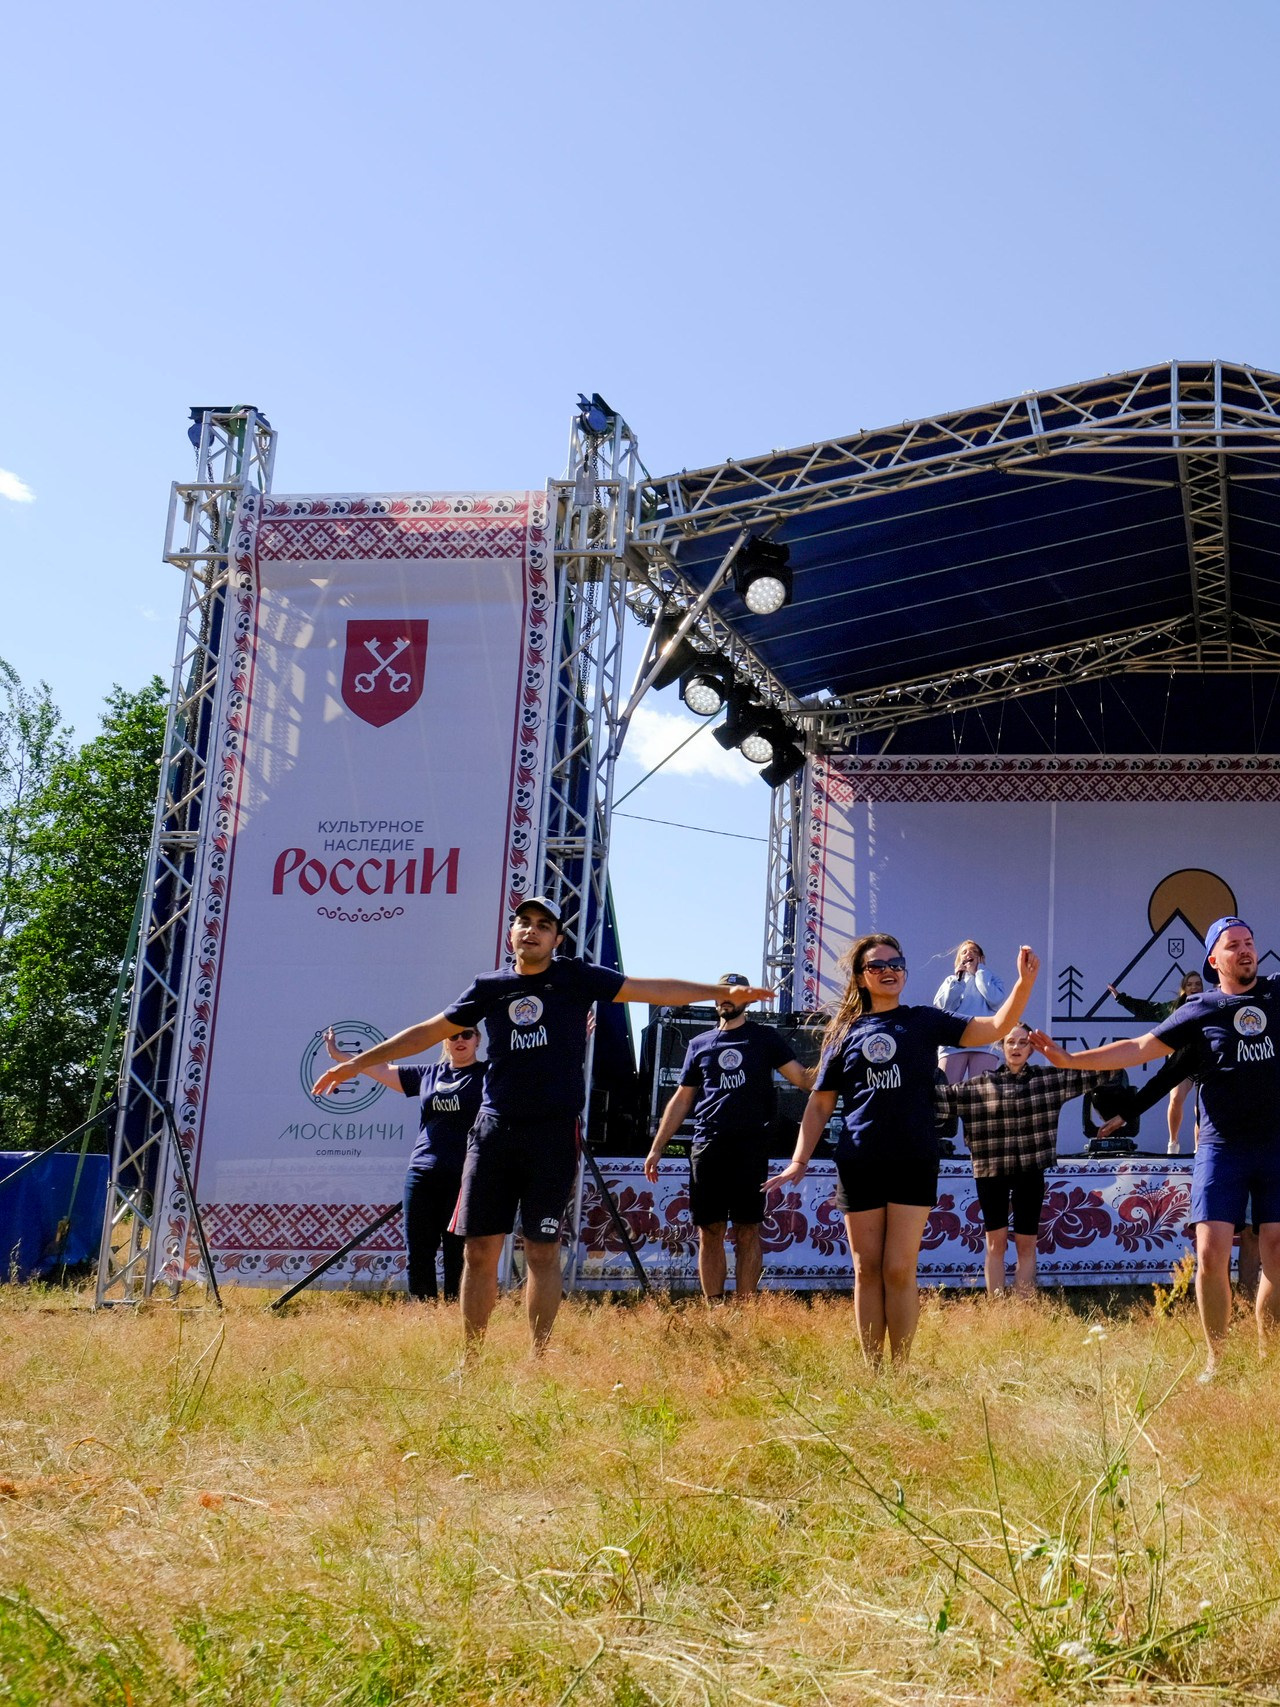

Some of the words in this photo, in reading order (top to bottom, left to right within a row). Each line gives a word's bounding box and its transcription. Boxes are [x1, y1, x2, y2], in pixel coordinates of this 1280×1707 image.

[318, 820, 424, 833] КУЛЬТУРНОЕ
[324, 839, 415, 853] НАСЛЕДИЕ
[278, 1123, 404, 1140] МОСКВИЧИ
[316, 1148, 362, 1157] community
